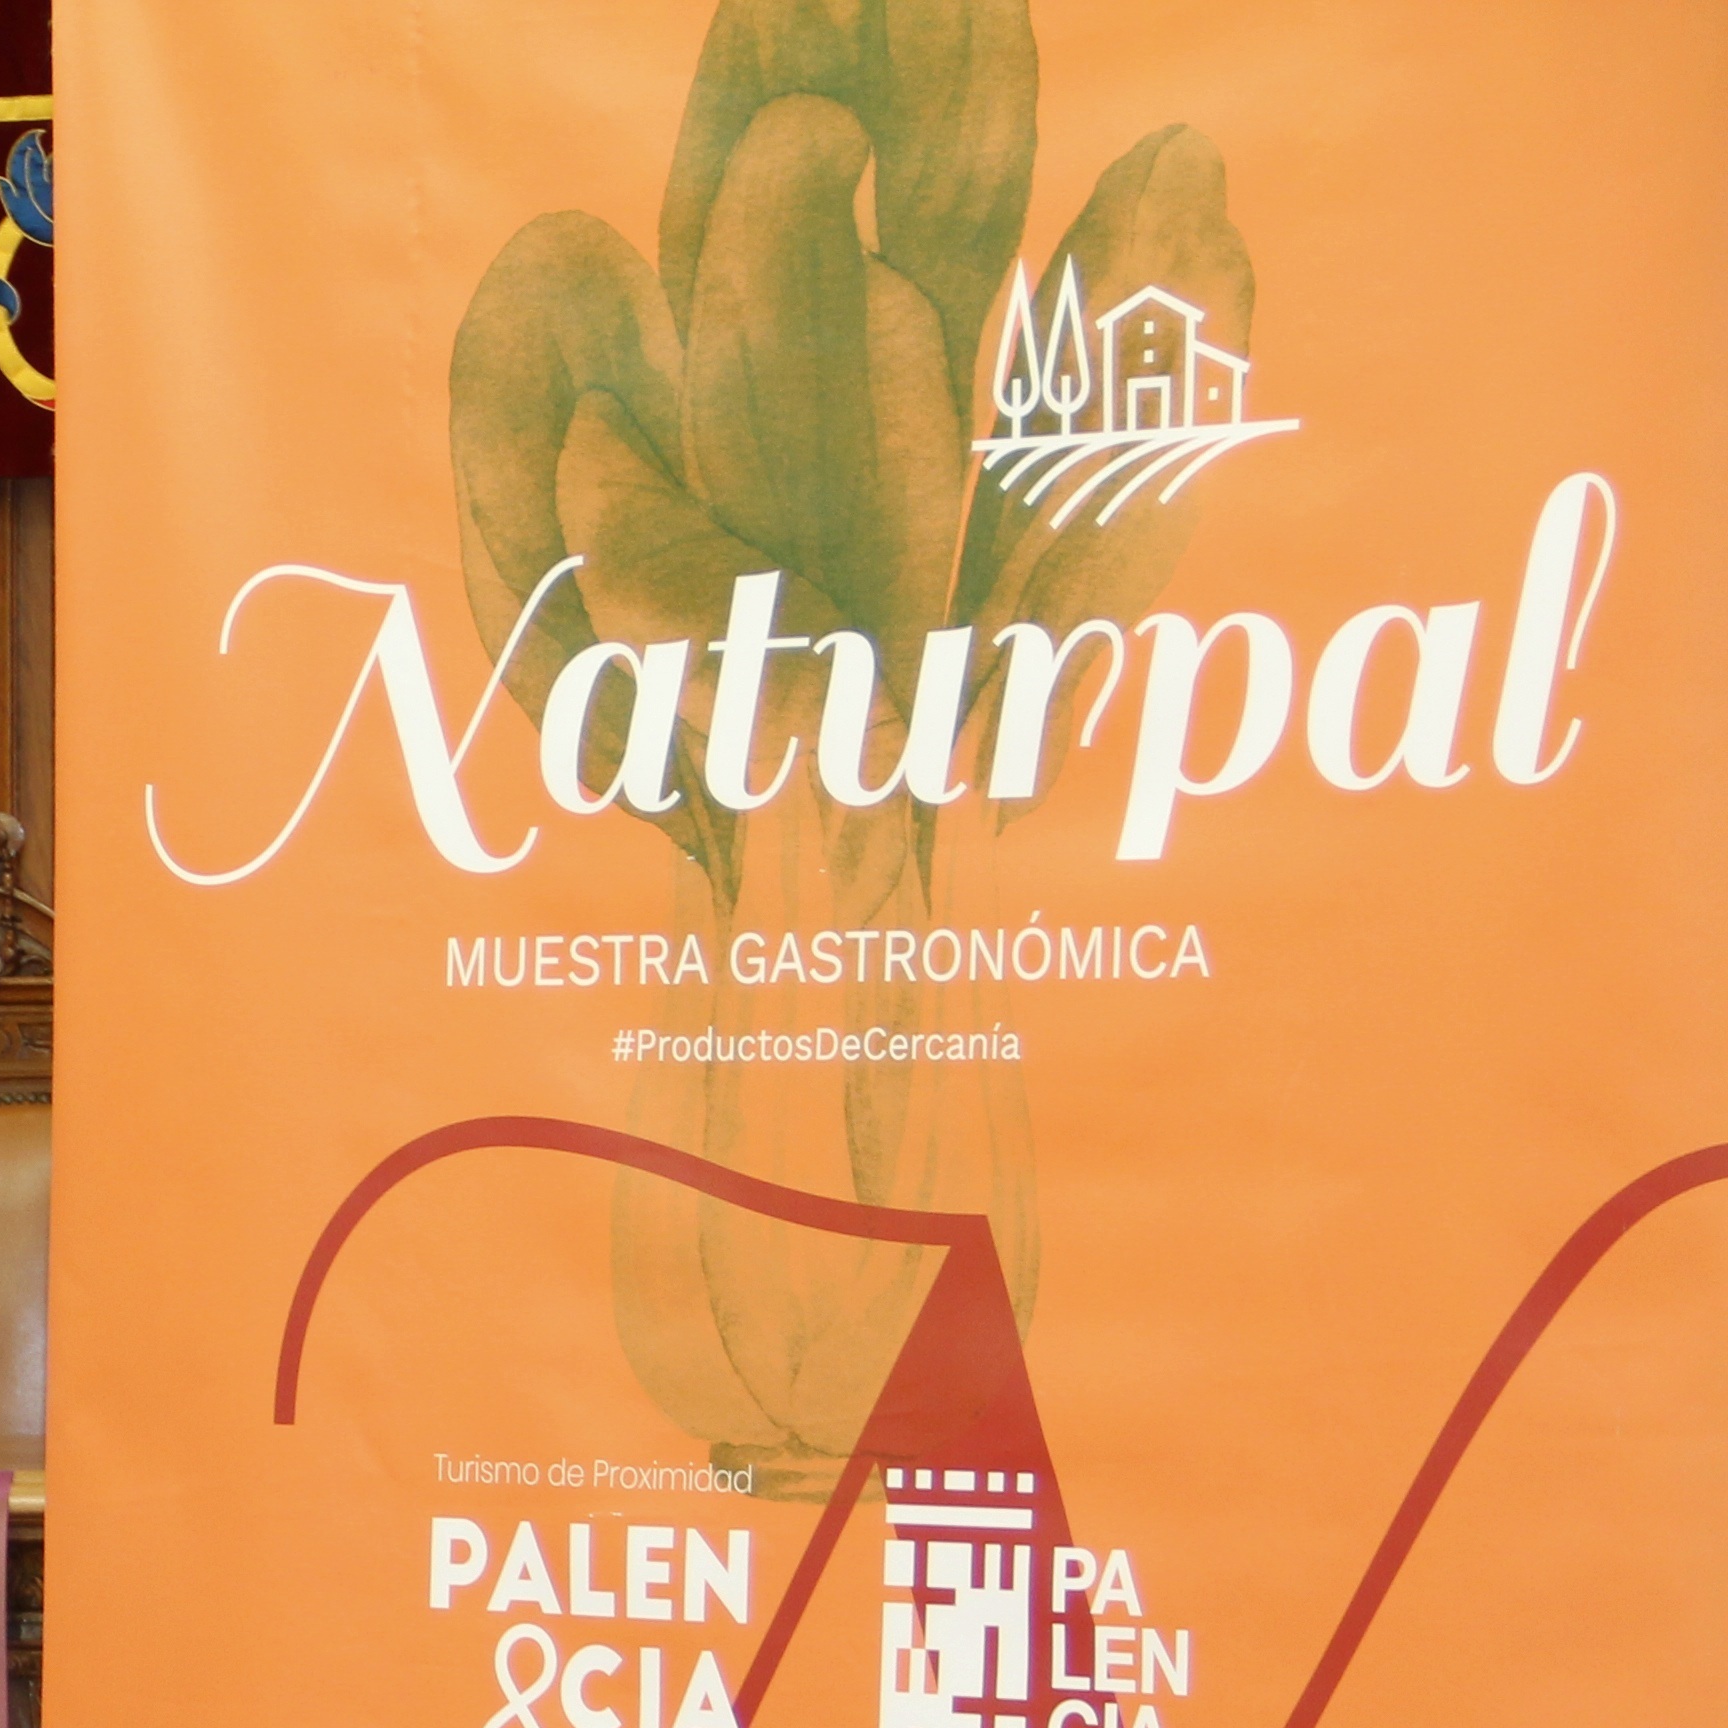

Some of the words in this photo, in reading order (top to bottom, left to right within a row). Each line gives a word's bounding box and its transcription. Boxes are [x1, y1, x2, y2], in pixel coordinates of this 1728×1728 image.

[144, 472, 1616, 887] Naturpal
[444, 931, 708, 989] MUESTRA
[730, 909, 1211, 986] GASTRONÓMICA
[612, 1023, 1022, 1065] #ProductosDeCercanía
[434, 1453, 540, 1487] Turismo
[547, 1457, 585, 1489] de
[593, 1460, 753, 1494] Proximidad
[429, 1516, 751, 1624] PALEN
[1051, 1547, 1142, 1617] PA
[1050, 1623, 1189, 1696] LEN
